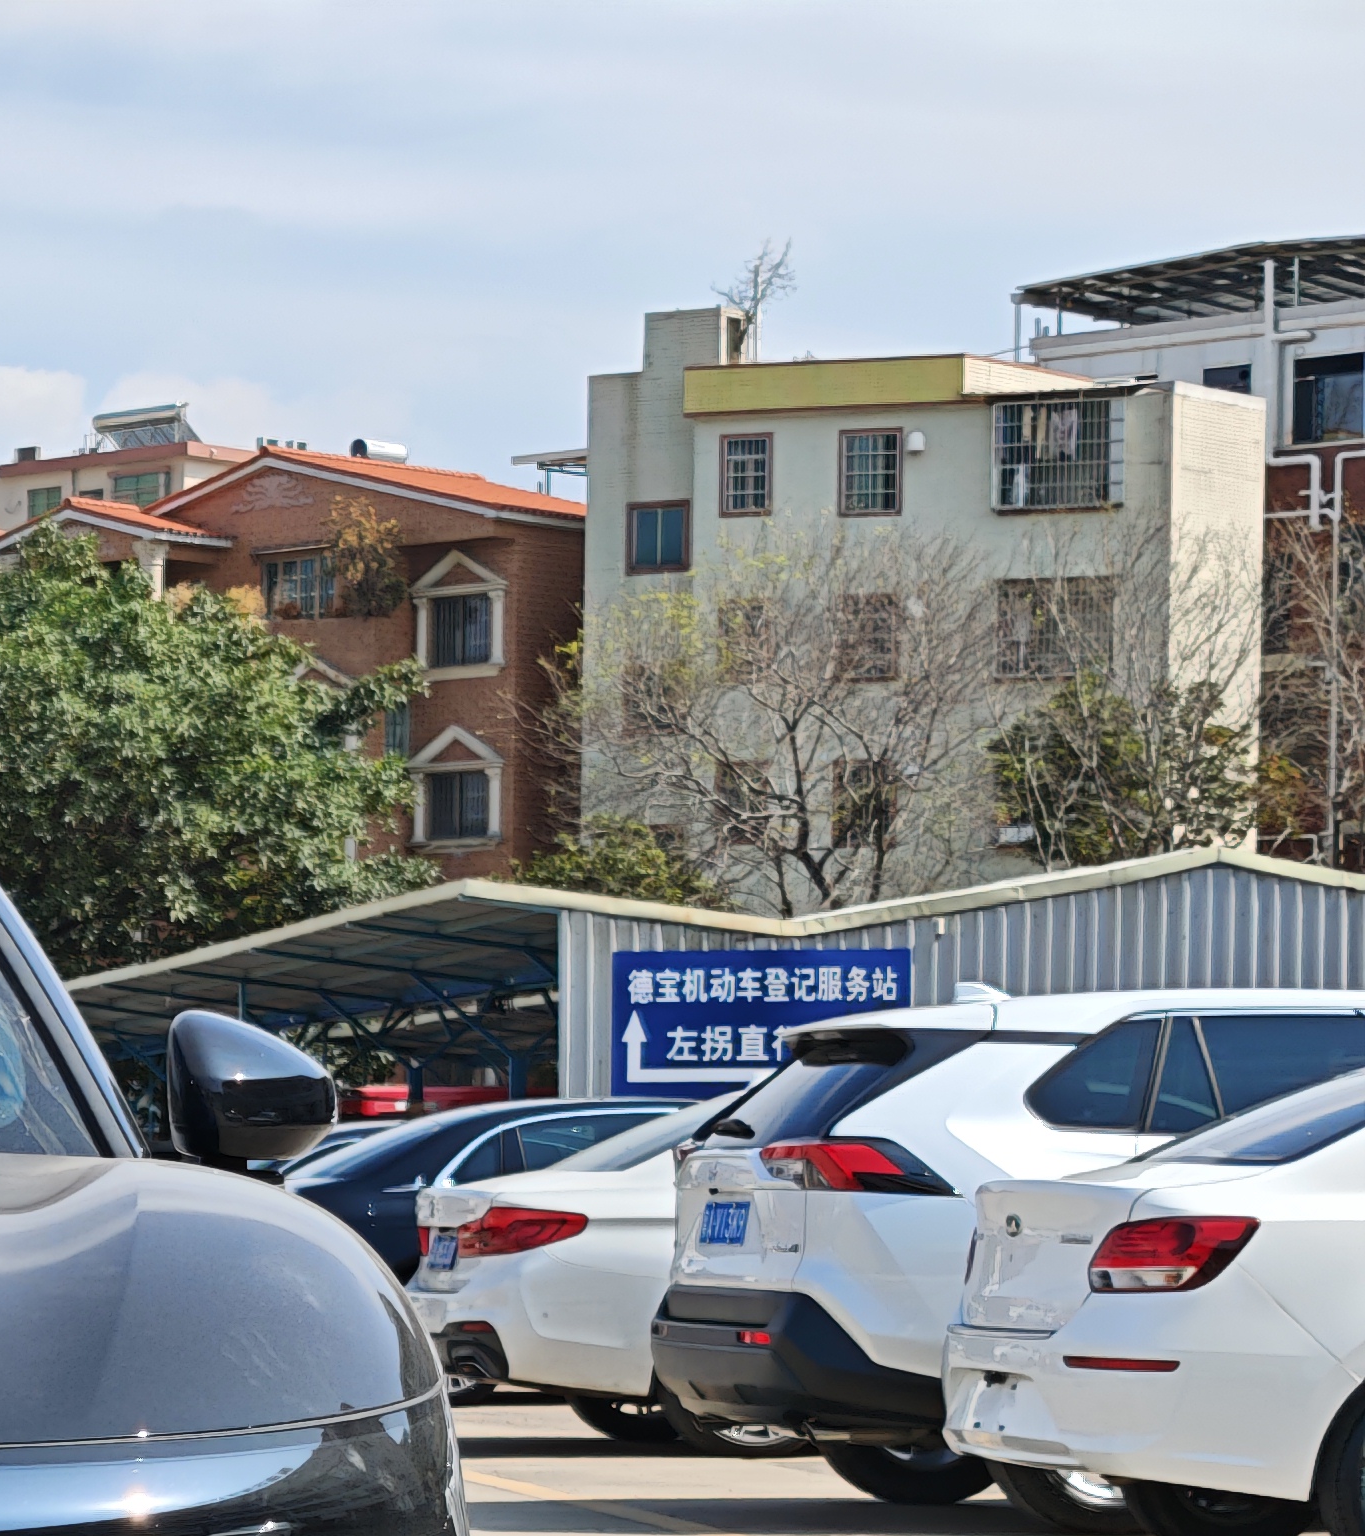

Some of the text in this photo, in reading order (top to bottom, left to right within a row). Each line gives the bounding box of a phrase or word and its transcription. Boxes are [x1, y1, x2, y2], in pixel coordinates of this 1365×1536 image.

[627, 965, 898, 1004] 德宝机动车登记服务站
